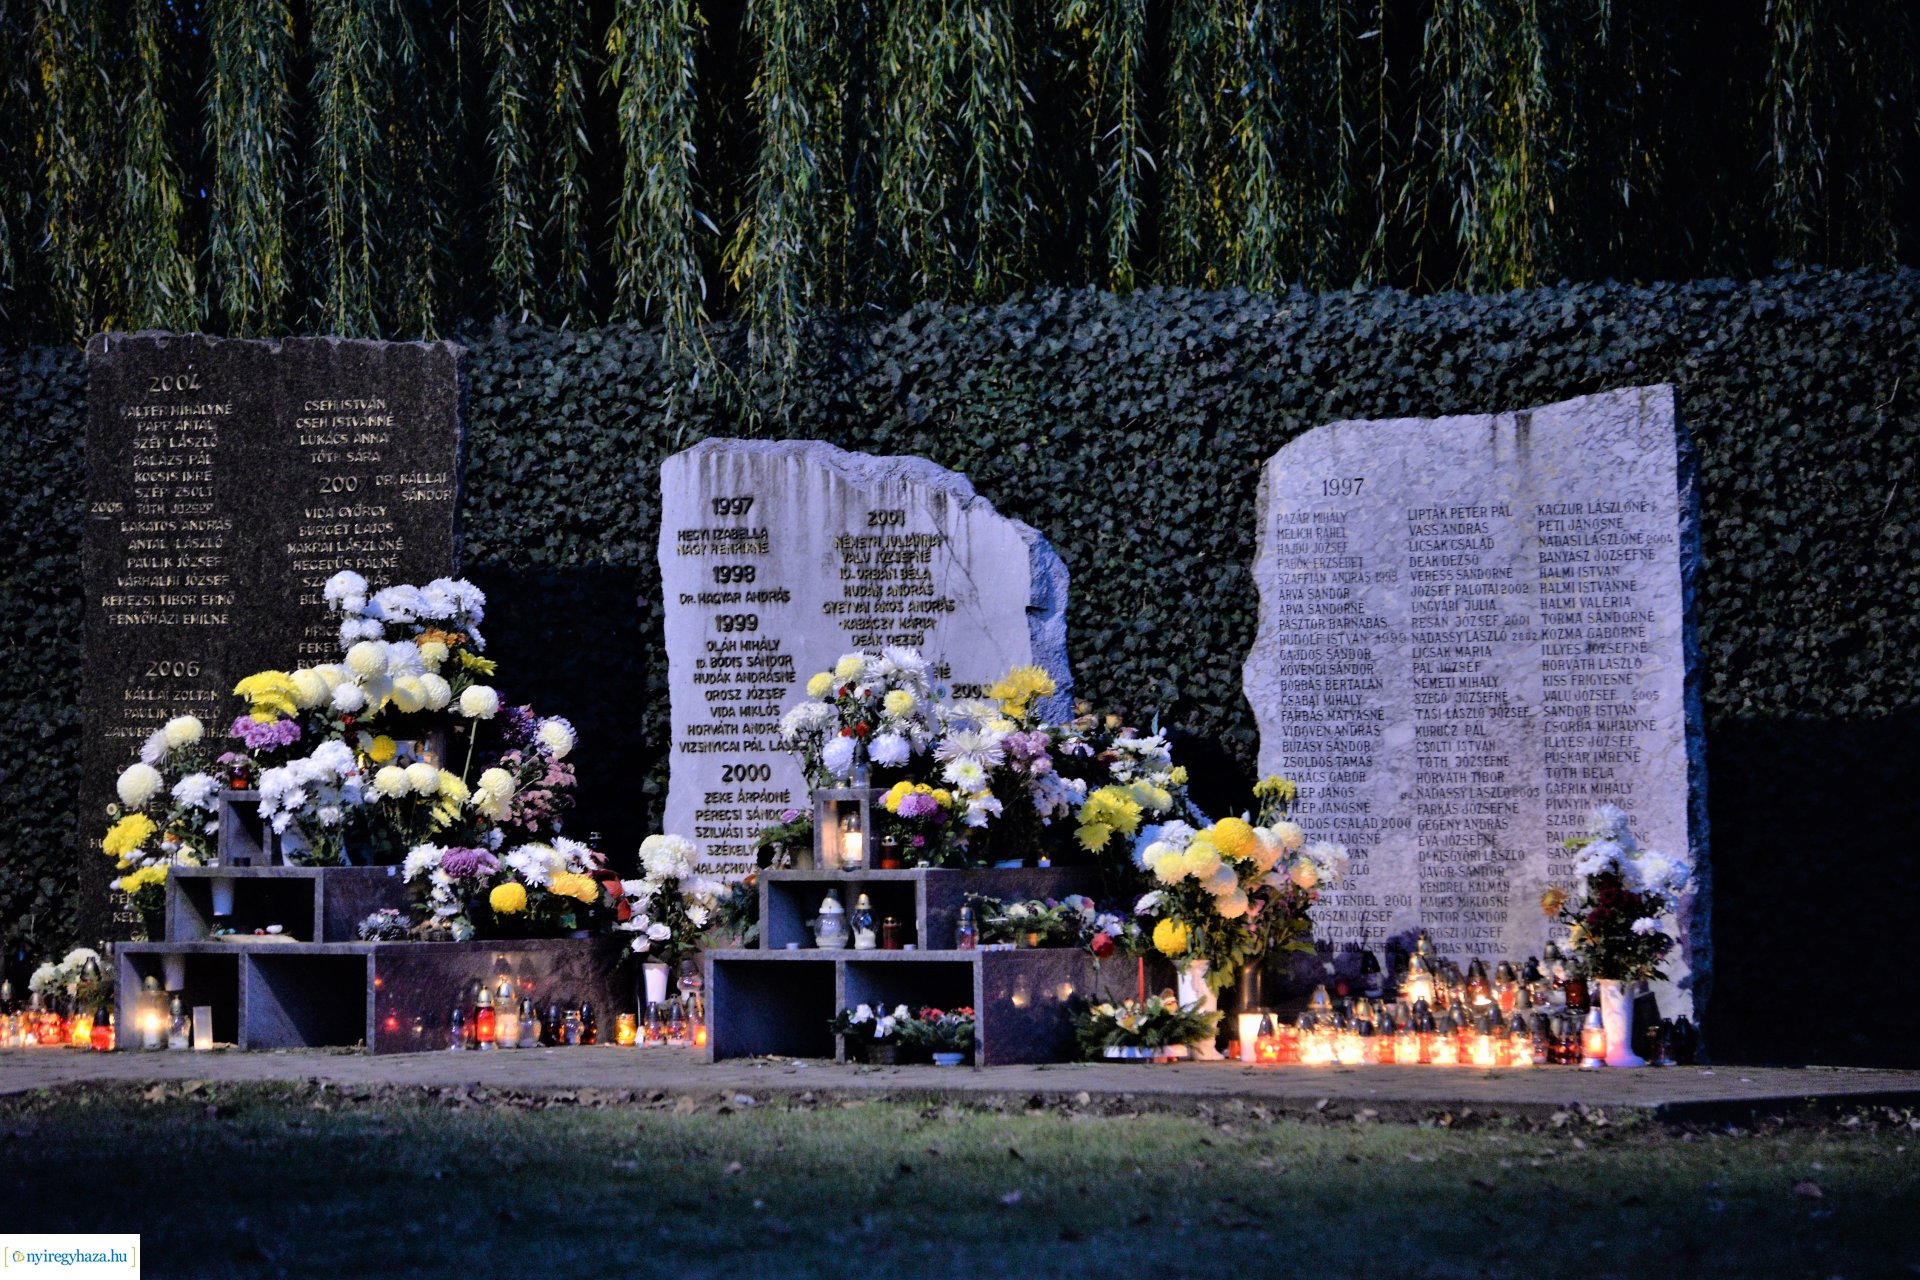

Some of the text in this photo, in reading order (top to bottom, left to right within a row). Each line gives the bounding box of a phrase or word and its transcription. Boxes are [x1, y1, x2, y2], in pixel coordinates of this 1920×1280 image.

[150, 374, 202, 393] 2004
[304, 400, 337, 411] CSEH
[174, 420, 214, 432] ANTAL
[296, 418, 328, 429] CSEH
[169, 433, 218, 449] LÁSZLÓ
[353, 433, 390, 444] ANNA
[188, 450, 214, 465] PÁL
[134, 470, 213, 483] KOCSIS IMRE
[319, 475, 368, 494] 2007
[1322, 478, 1365, 497] 1997
[174, 486, 213, 498] ZSOLT
[304, 507, 334, 519] VIDA
[712, 497, 754, 516] 1997
[1537, 503, 1583, 516] KACZUR
[868, 510, 905, 527] 2001
[121, 521, 177, 533] LAKATOS
[354, 522, 394, 535] LAJOS
[1409, 524, 1439, 536] VASS
[1538, 519, 1565, 532] PETI
[678, 528, 769, 542] HEGYI IZABELLA
[834, 532, 882, 549] NÉMETH
[1276, 528, 1313, 540] MELICH
[128, 539, 168, 551] ANTAL
[677, 545, 707, 556] NAGY
[876, 547, 931, 563] JÓZSEFNÉ
[127, 557, 173, 569] PAULIK
[713, 565, 756, 584] 1998
[857, 565, 932, 580] ORBÁN BÉLA
[1410, 569, 1454, 582] VERESS
[1539, 566, 1574, 579] HALMI
[844, 580, 934, 597] HUDÁK ANDRÁS
[1500, 583, 1529, 595] 2002
[1539, 582, 1575, 594] HALMI
[159, 595, 197, 607] TIBOR
[698, 587, 792, 605] MAGYAR ANDRÁS
[874, 597, 903, 613] ÁKOS
[908, 595, 956, 613] ANDRÁS
[1540, 597, 1576, 609] HALMI
[715, 614, 759, 633] 1999
[1504, 615, 1530, 626] 2001
[1540, 612, 1583, 625] TORMA
[852, 631, 883, 647] DEÁK
[1541, 628, 1583, 640] KOZMA
[707, 636, 780, 652] OLÁH MIHÁLY
[747, 651, 793, 667] SÁNDOR
[145, 660, 201, 678] 2006
[694, 666, 797, 684] HUDÁK ANDRÁSNÉ
[1543, 674, 1567, 687] KISS
[705, 685, 787, 701] OROSZ JÓZSEF
[1632, 690, 1660, 701] 2005
[123, 708, 168, 719] PAULIK
[710, 701, 780, 718] VIDA MIKLÓS
[687, 720, 739, 736] HORVÁTH
[1544, 720, 1592, 733] CSORBA
[743, 737, 766, 752] PÁL
[1283, 756, 1333, 768] ZSOLDOS
[721, 764, 771, 783] 2000
[1471, 771, 1504, 783] TIBOR
[704, 788, 791, 804] ZEKE ÁRPÁDNÉ
[1545, 798, 1591, 810] PIVNYIK
[695, 809, 743, 822] PERECSI
[1381, 817, 1412, 829] 2000
[695, 823, 744, 838] SZILVÁSI
[1336, 895, 1412, 907] VENDEL 2001
[1420, 911, 1459, 923] FINTOR
